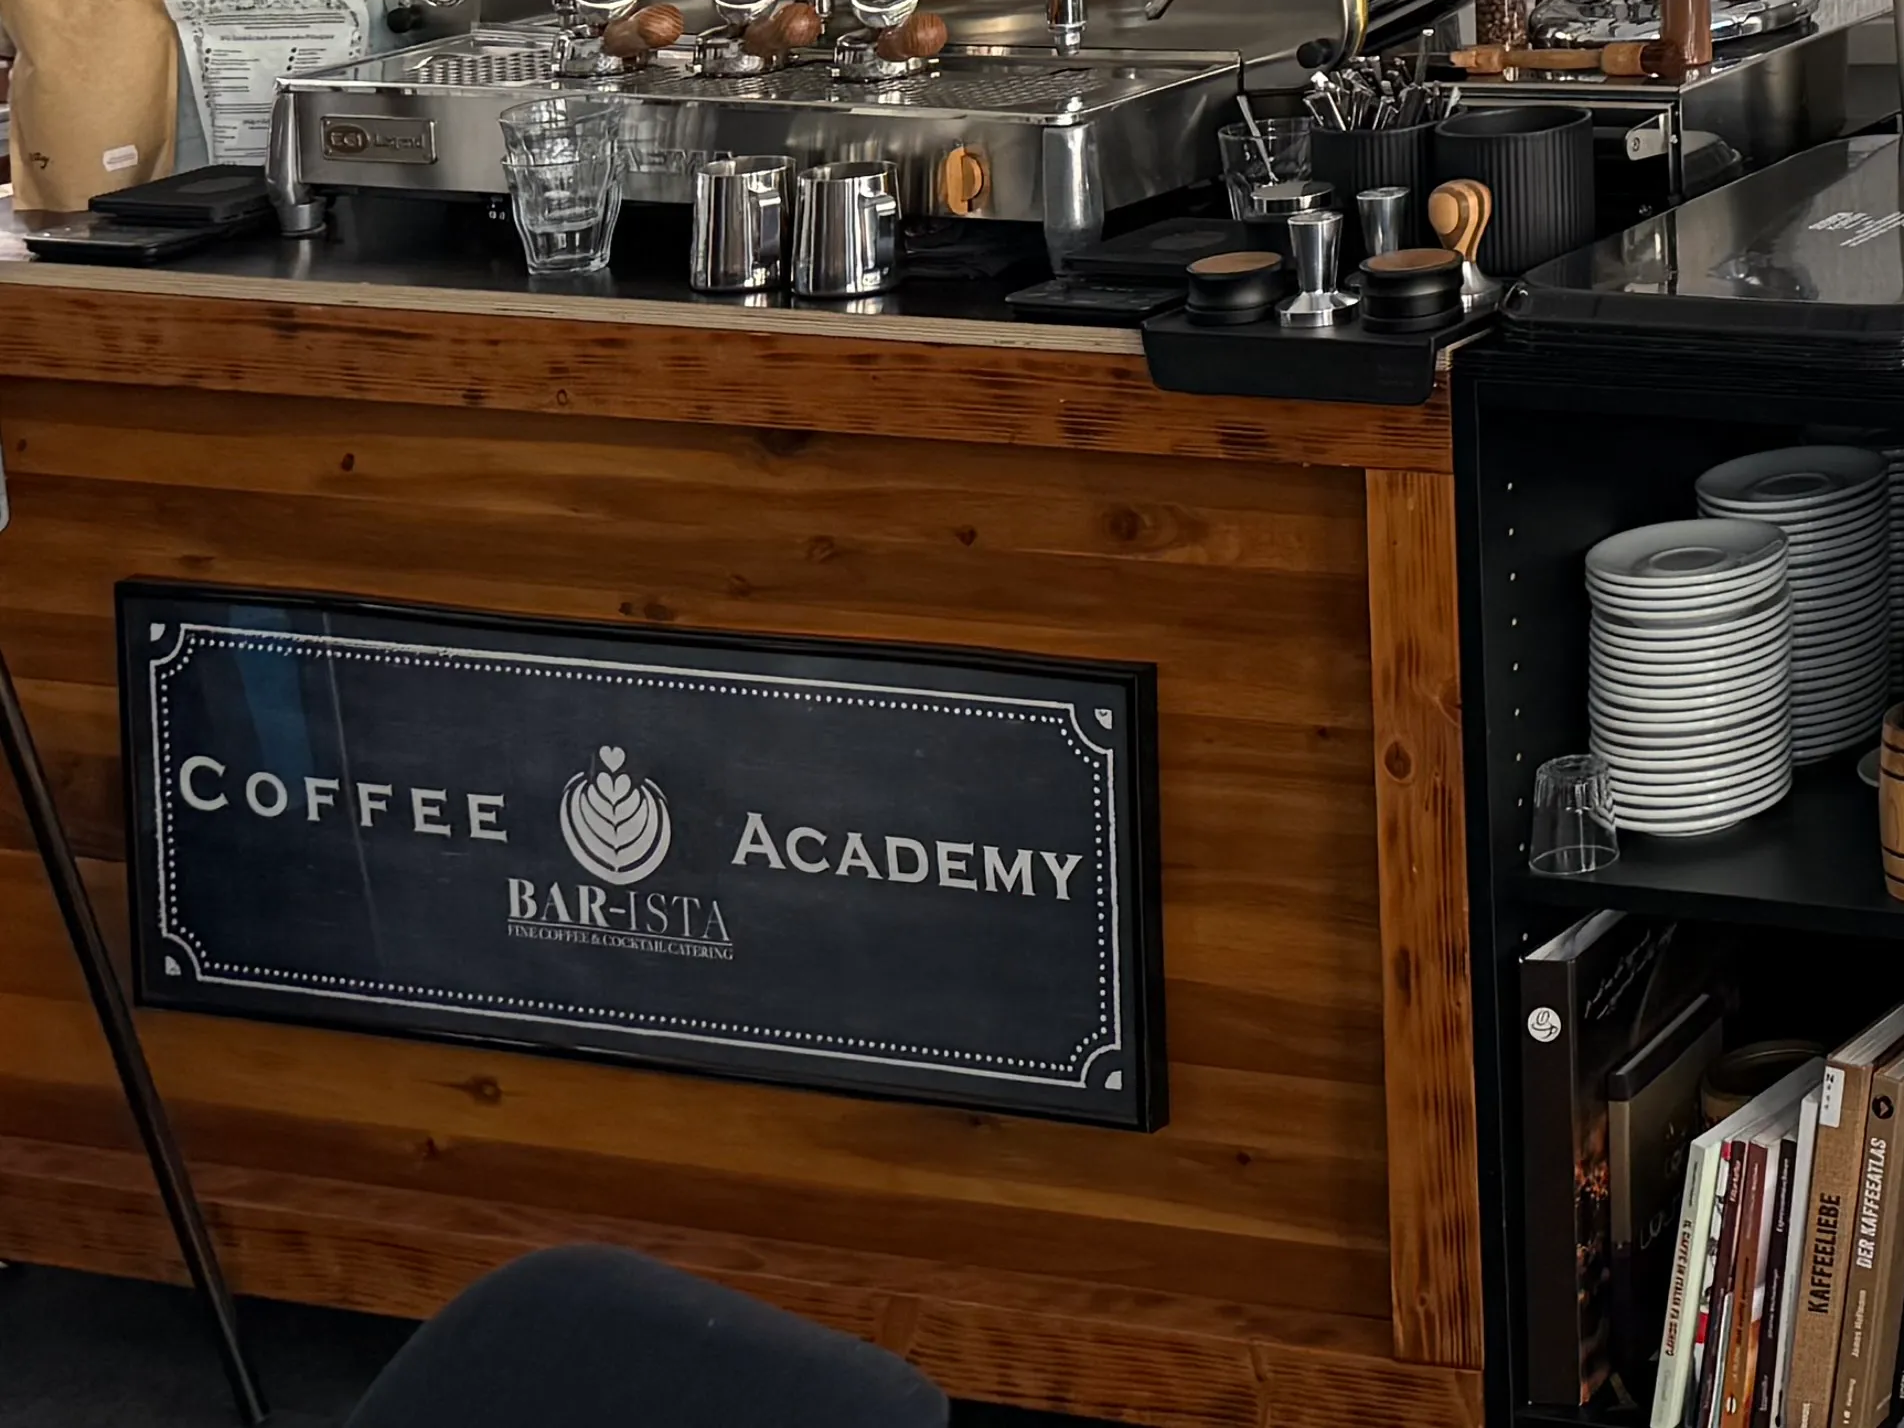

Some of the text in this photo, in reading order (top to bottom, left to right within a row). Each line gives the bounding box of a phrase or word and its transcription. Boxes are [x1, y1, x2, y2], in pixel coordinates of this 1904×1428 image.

[731, 811, 1083, 902] ACADEMY
[507, 877, 733, 941] BAR-ISTA
[507, 923, 537, 939] FINE
[539, 926, 590, 945] COFFEE
[603, 932, 667, 954] COCKTAIL
[669, 940, 734, 962] CATERING
[1856, 1137, 1888, 1269] DER KAFFEEATLAS
[1807, 1192, 1842, 1314] KAFFEELIEBE
